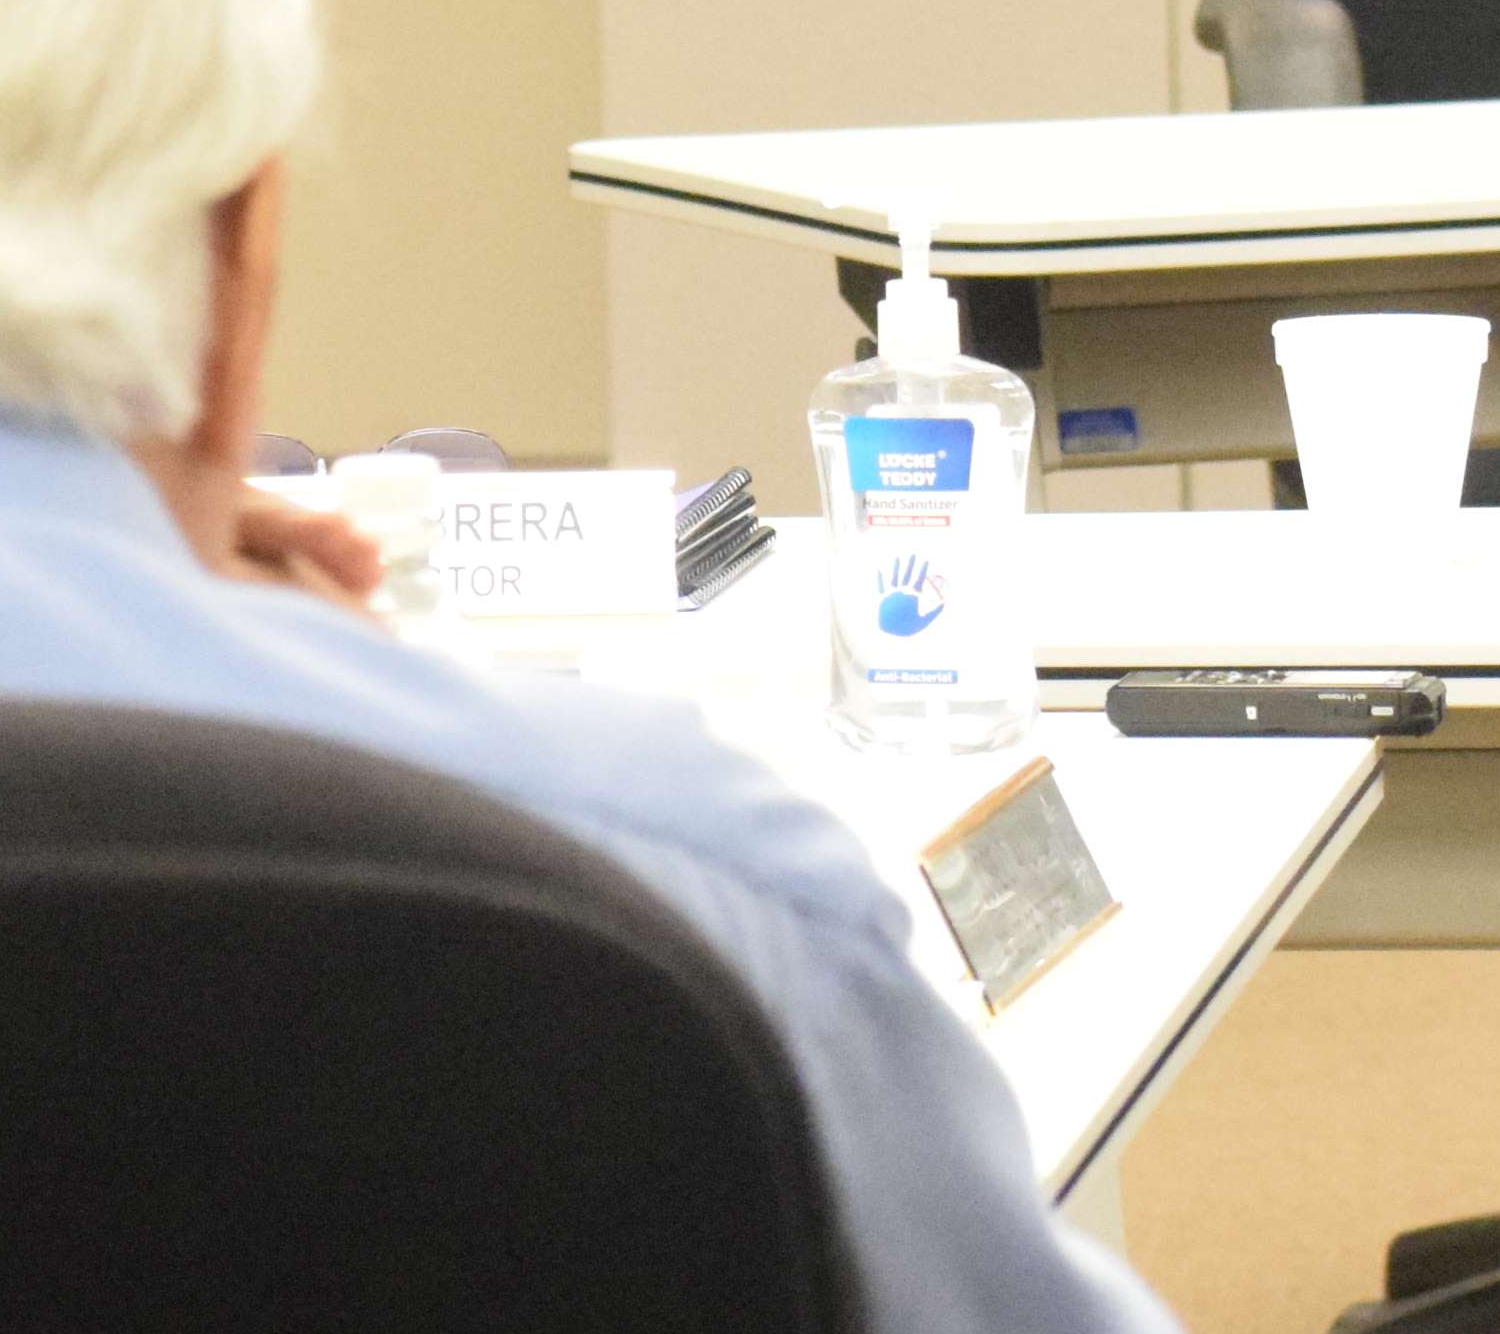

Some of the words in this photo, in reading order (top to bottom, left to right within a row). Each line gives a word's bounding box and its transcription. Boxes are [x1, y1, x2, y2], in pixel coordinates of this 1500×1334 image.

[879, 471, 937, 486] TEDDY
[862, 498, 896, 510] Hand
[899, 498, 959, 510] Sanitizer
[434, 565, 522, 597] TOR
